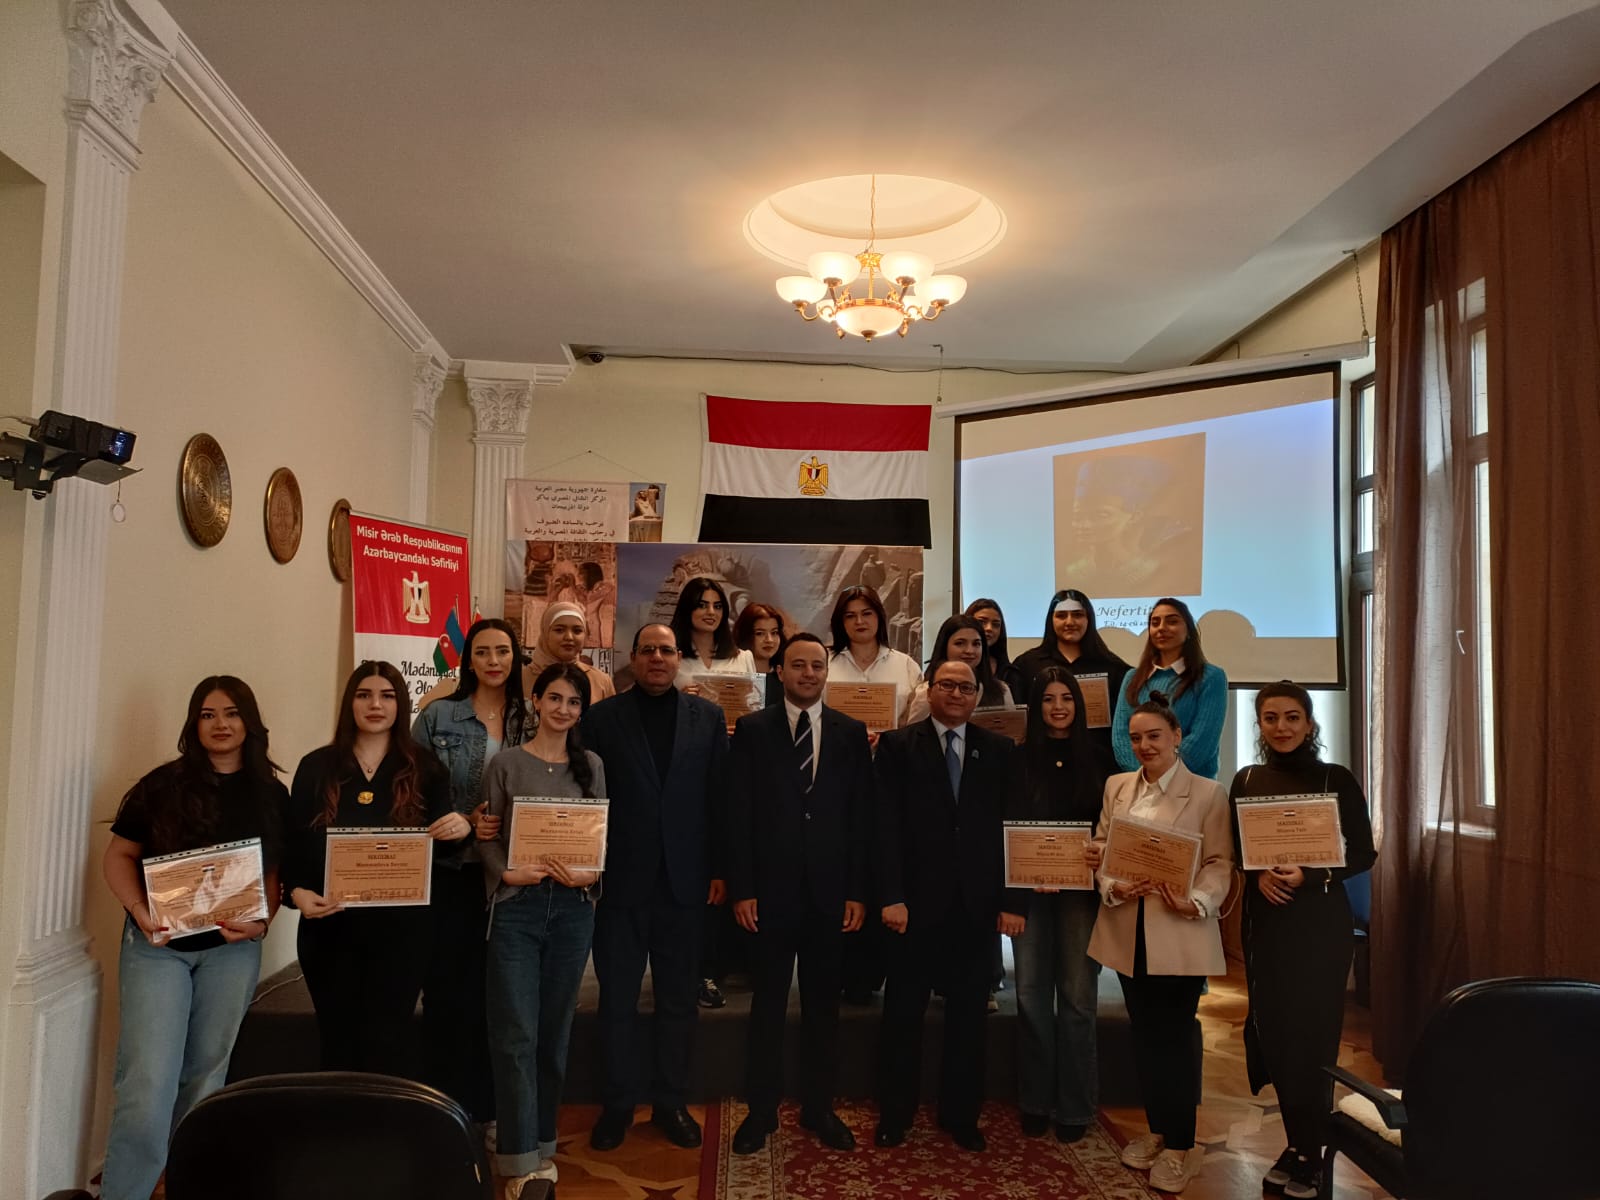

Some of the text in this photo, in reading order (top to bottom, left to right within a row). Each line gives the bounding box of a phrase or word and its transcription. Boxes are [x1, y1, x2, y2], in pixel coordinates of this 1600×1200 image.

[356, 525, 463, 555] Misir Ərəb Respublikasının
[363, 544, 459, 573] Azərbaycandakı Səfirliyi
